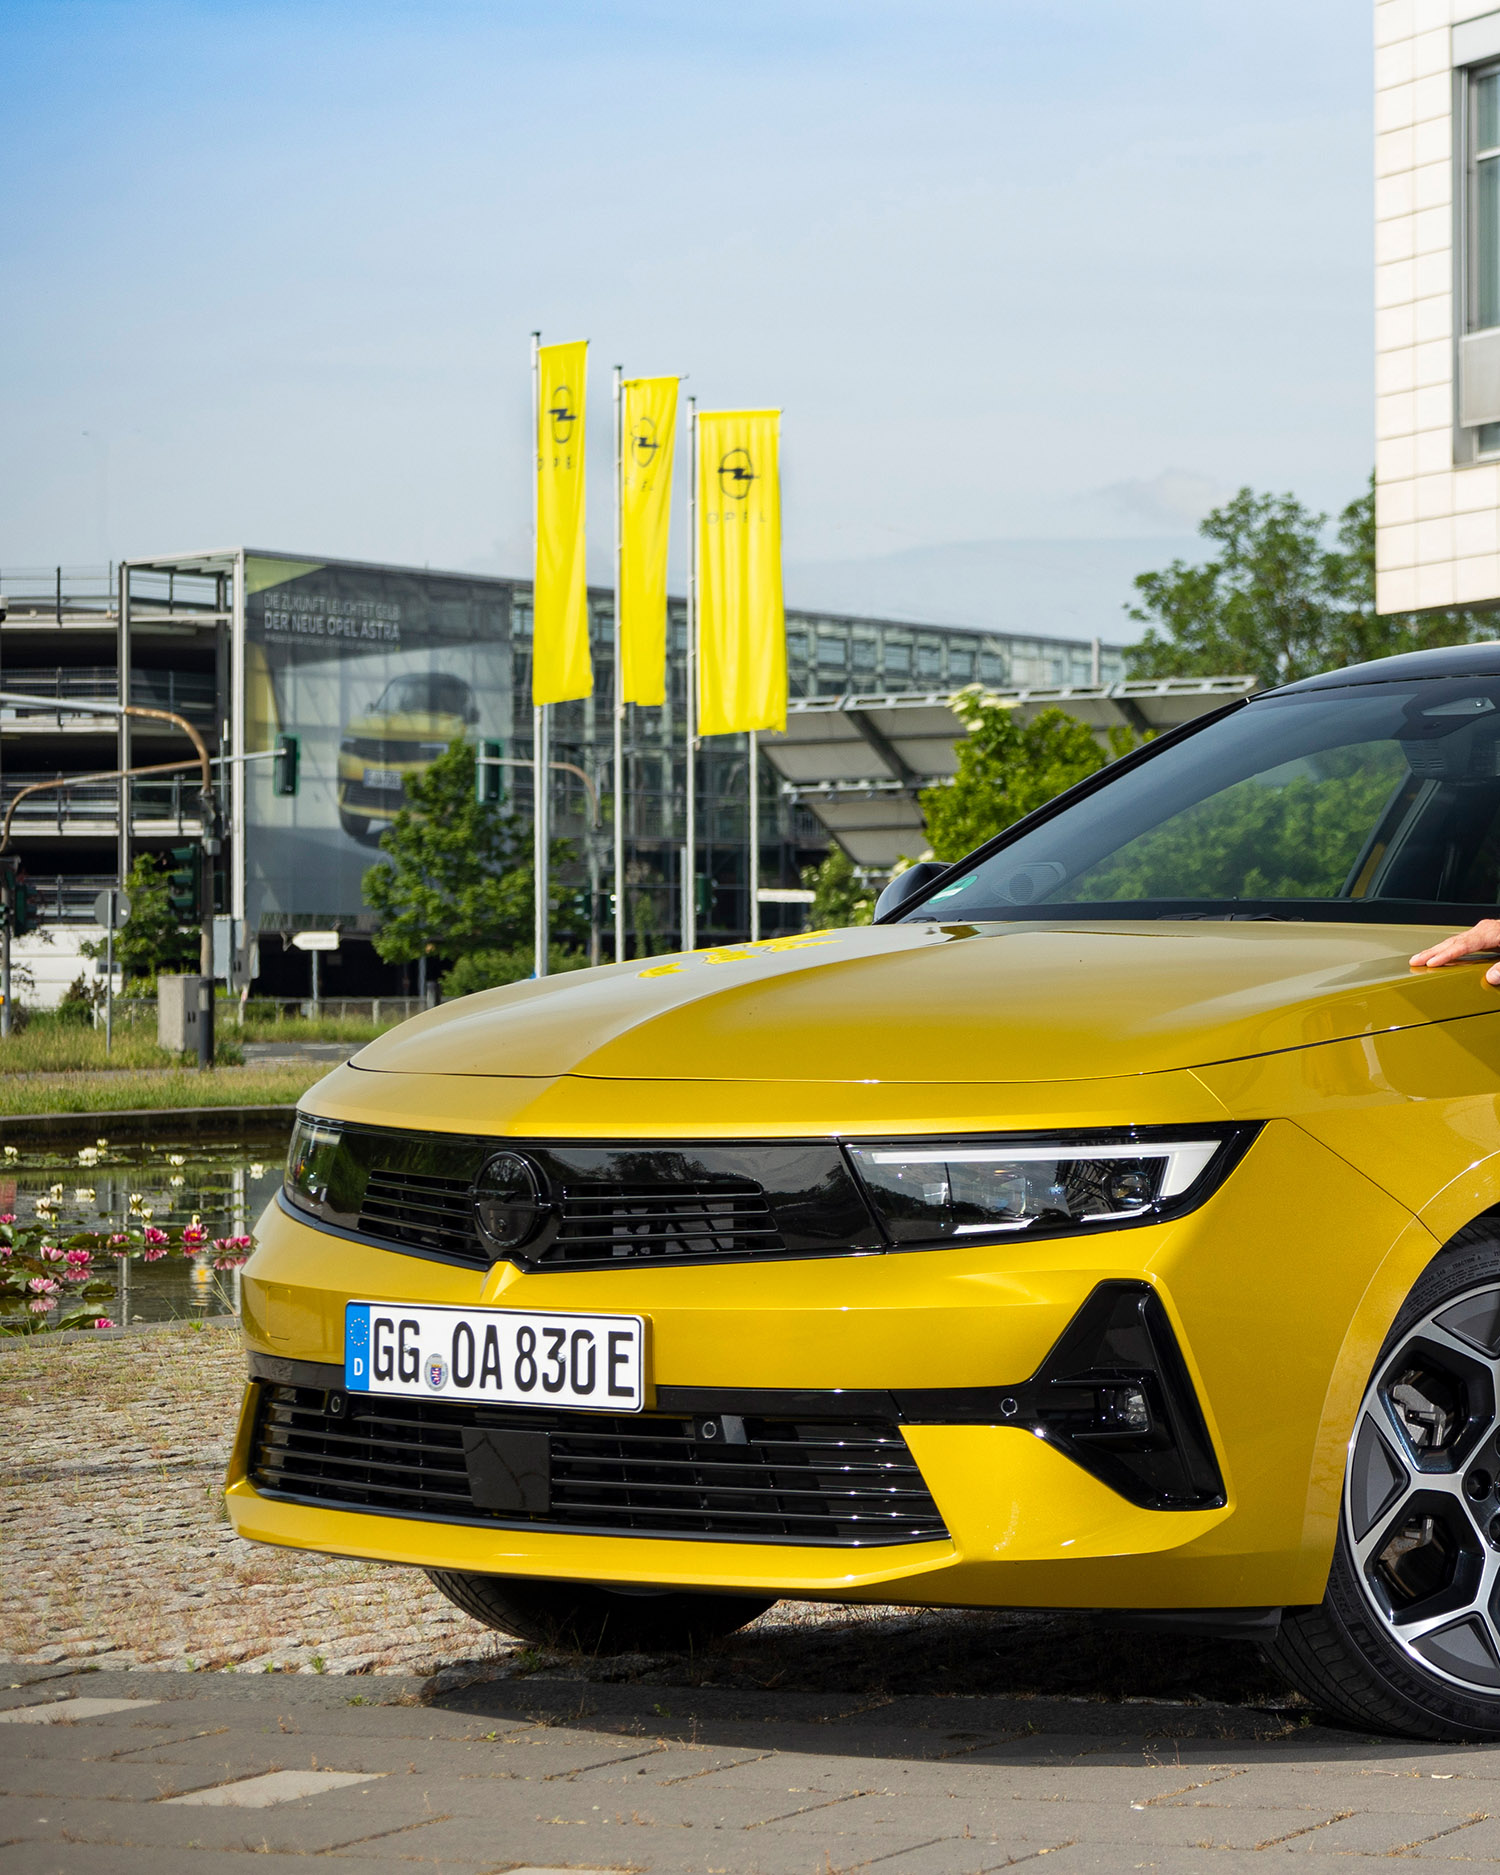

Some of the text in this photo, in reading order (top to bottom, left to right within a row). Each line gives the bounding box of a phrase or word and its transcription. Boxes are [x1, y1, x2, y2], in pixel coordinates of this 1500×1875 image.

[264, 593, 280, 608] DIE
[281, 594, 326, 612] ZUKUNFT
[264, 612, 401, 640] DER NEUE OPEL ASTRA
[373, 1318, 420, 1383] GG
[452, 1321, 503, 1390] OA
[353, 1357, 363, 1376] D
